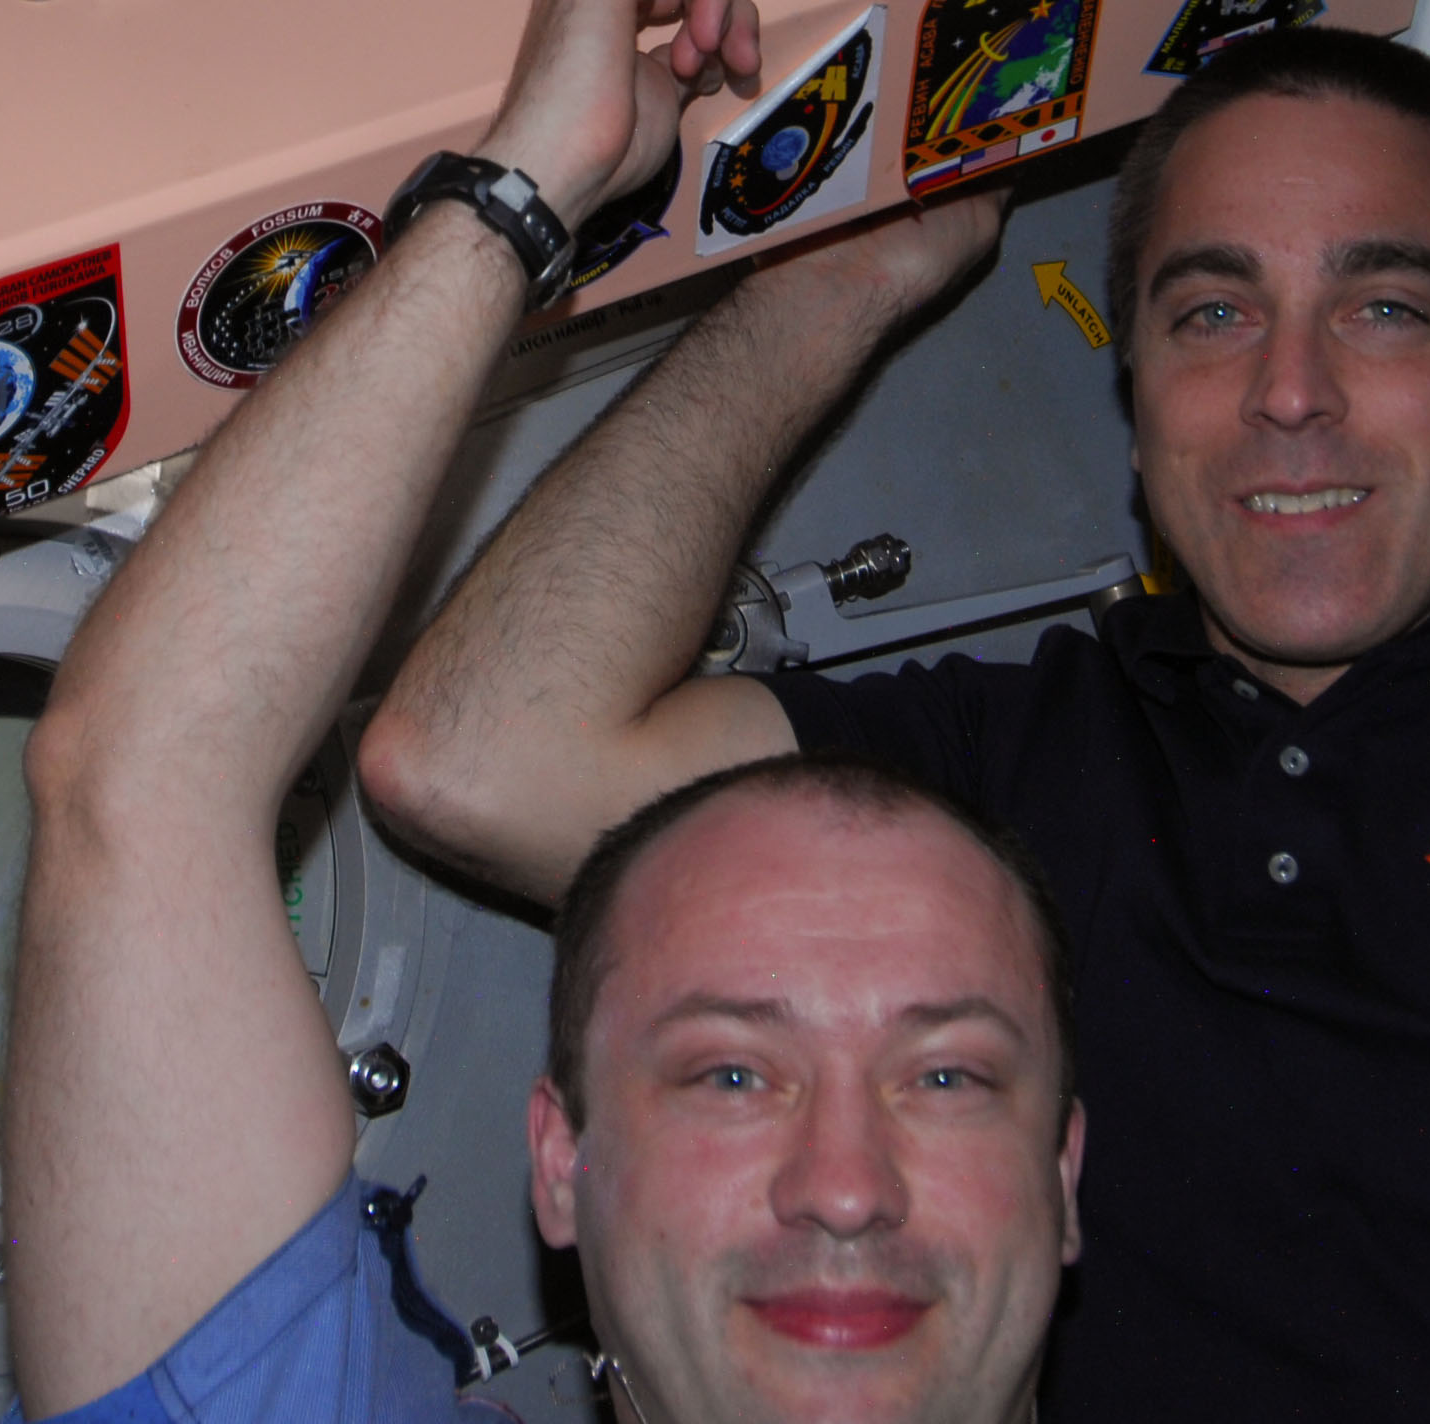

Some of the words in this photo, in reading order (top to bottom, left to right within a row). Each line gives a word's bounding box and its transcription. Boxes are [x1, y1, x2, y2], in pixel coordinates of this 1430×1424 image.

[910, 77, 931, 139] РЕВИН
[249, 204, 325, 238] FOSSUM
[763, 180, 818, 226] ПАДАЛКА
[185, 247, 235, 310] ВОЛКОВ
[571, 260, 610, 288] uipers
[1057, 283, 1105, 344] UNLATCH
[181, 329, 237, 385] ИВАНИШИН
[4, 478, 51, 508] 50
[57, 447, 107, 496] SHEPARD
